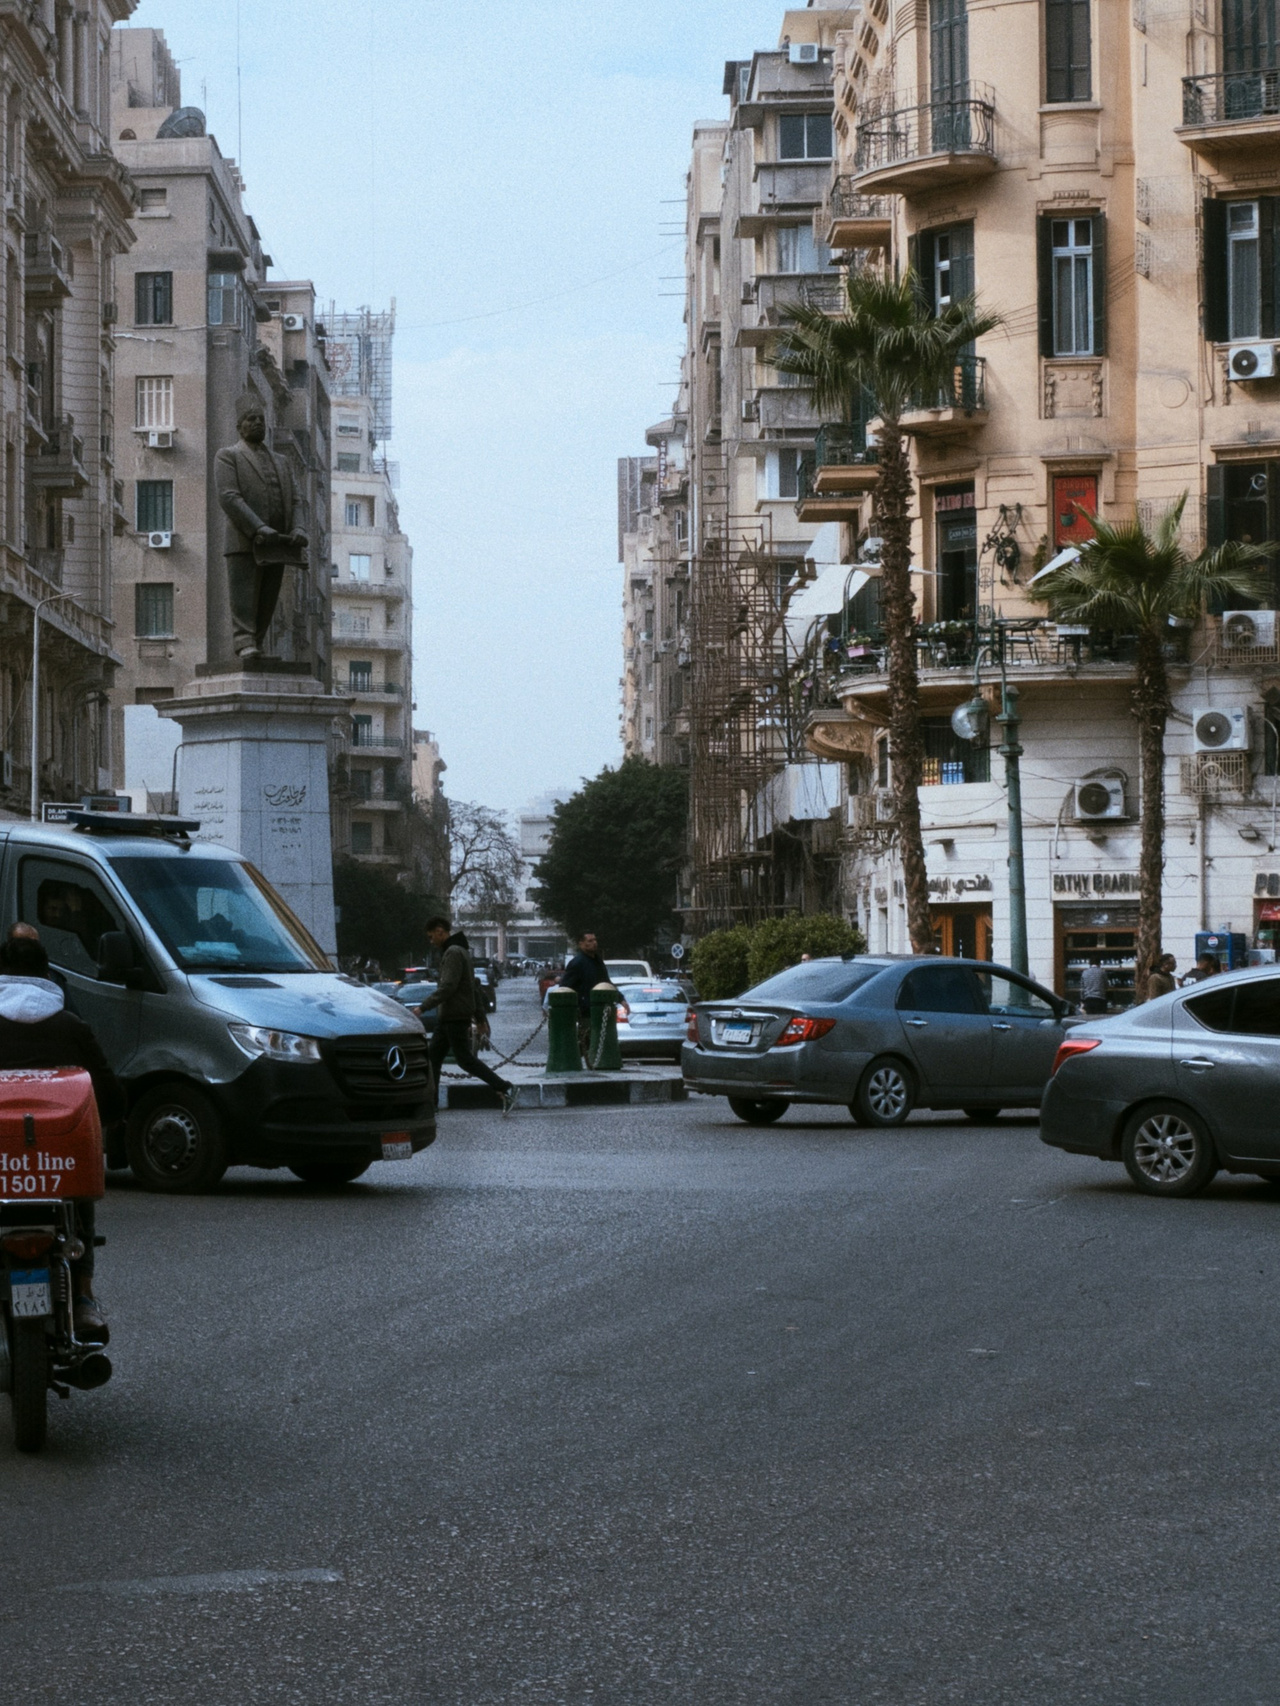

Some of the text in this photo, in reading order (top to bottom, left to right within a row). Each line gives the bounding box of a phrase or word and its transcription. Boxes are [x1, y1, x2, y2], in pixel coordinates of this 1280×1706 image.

[288, 784, 307, 807] محمد
[37, 1151, 76, 1171] line
[0, 1174, 61, 1194] 15017
